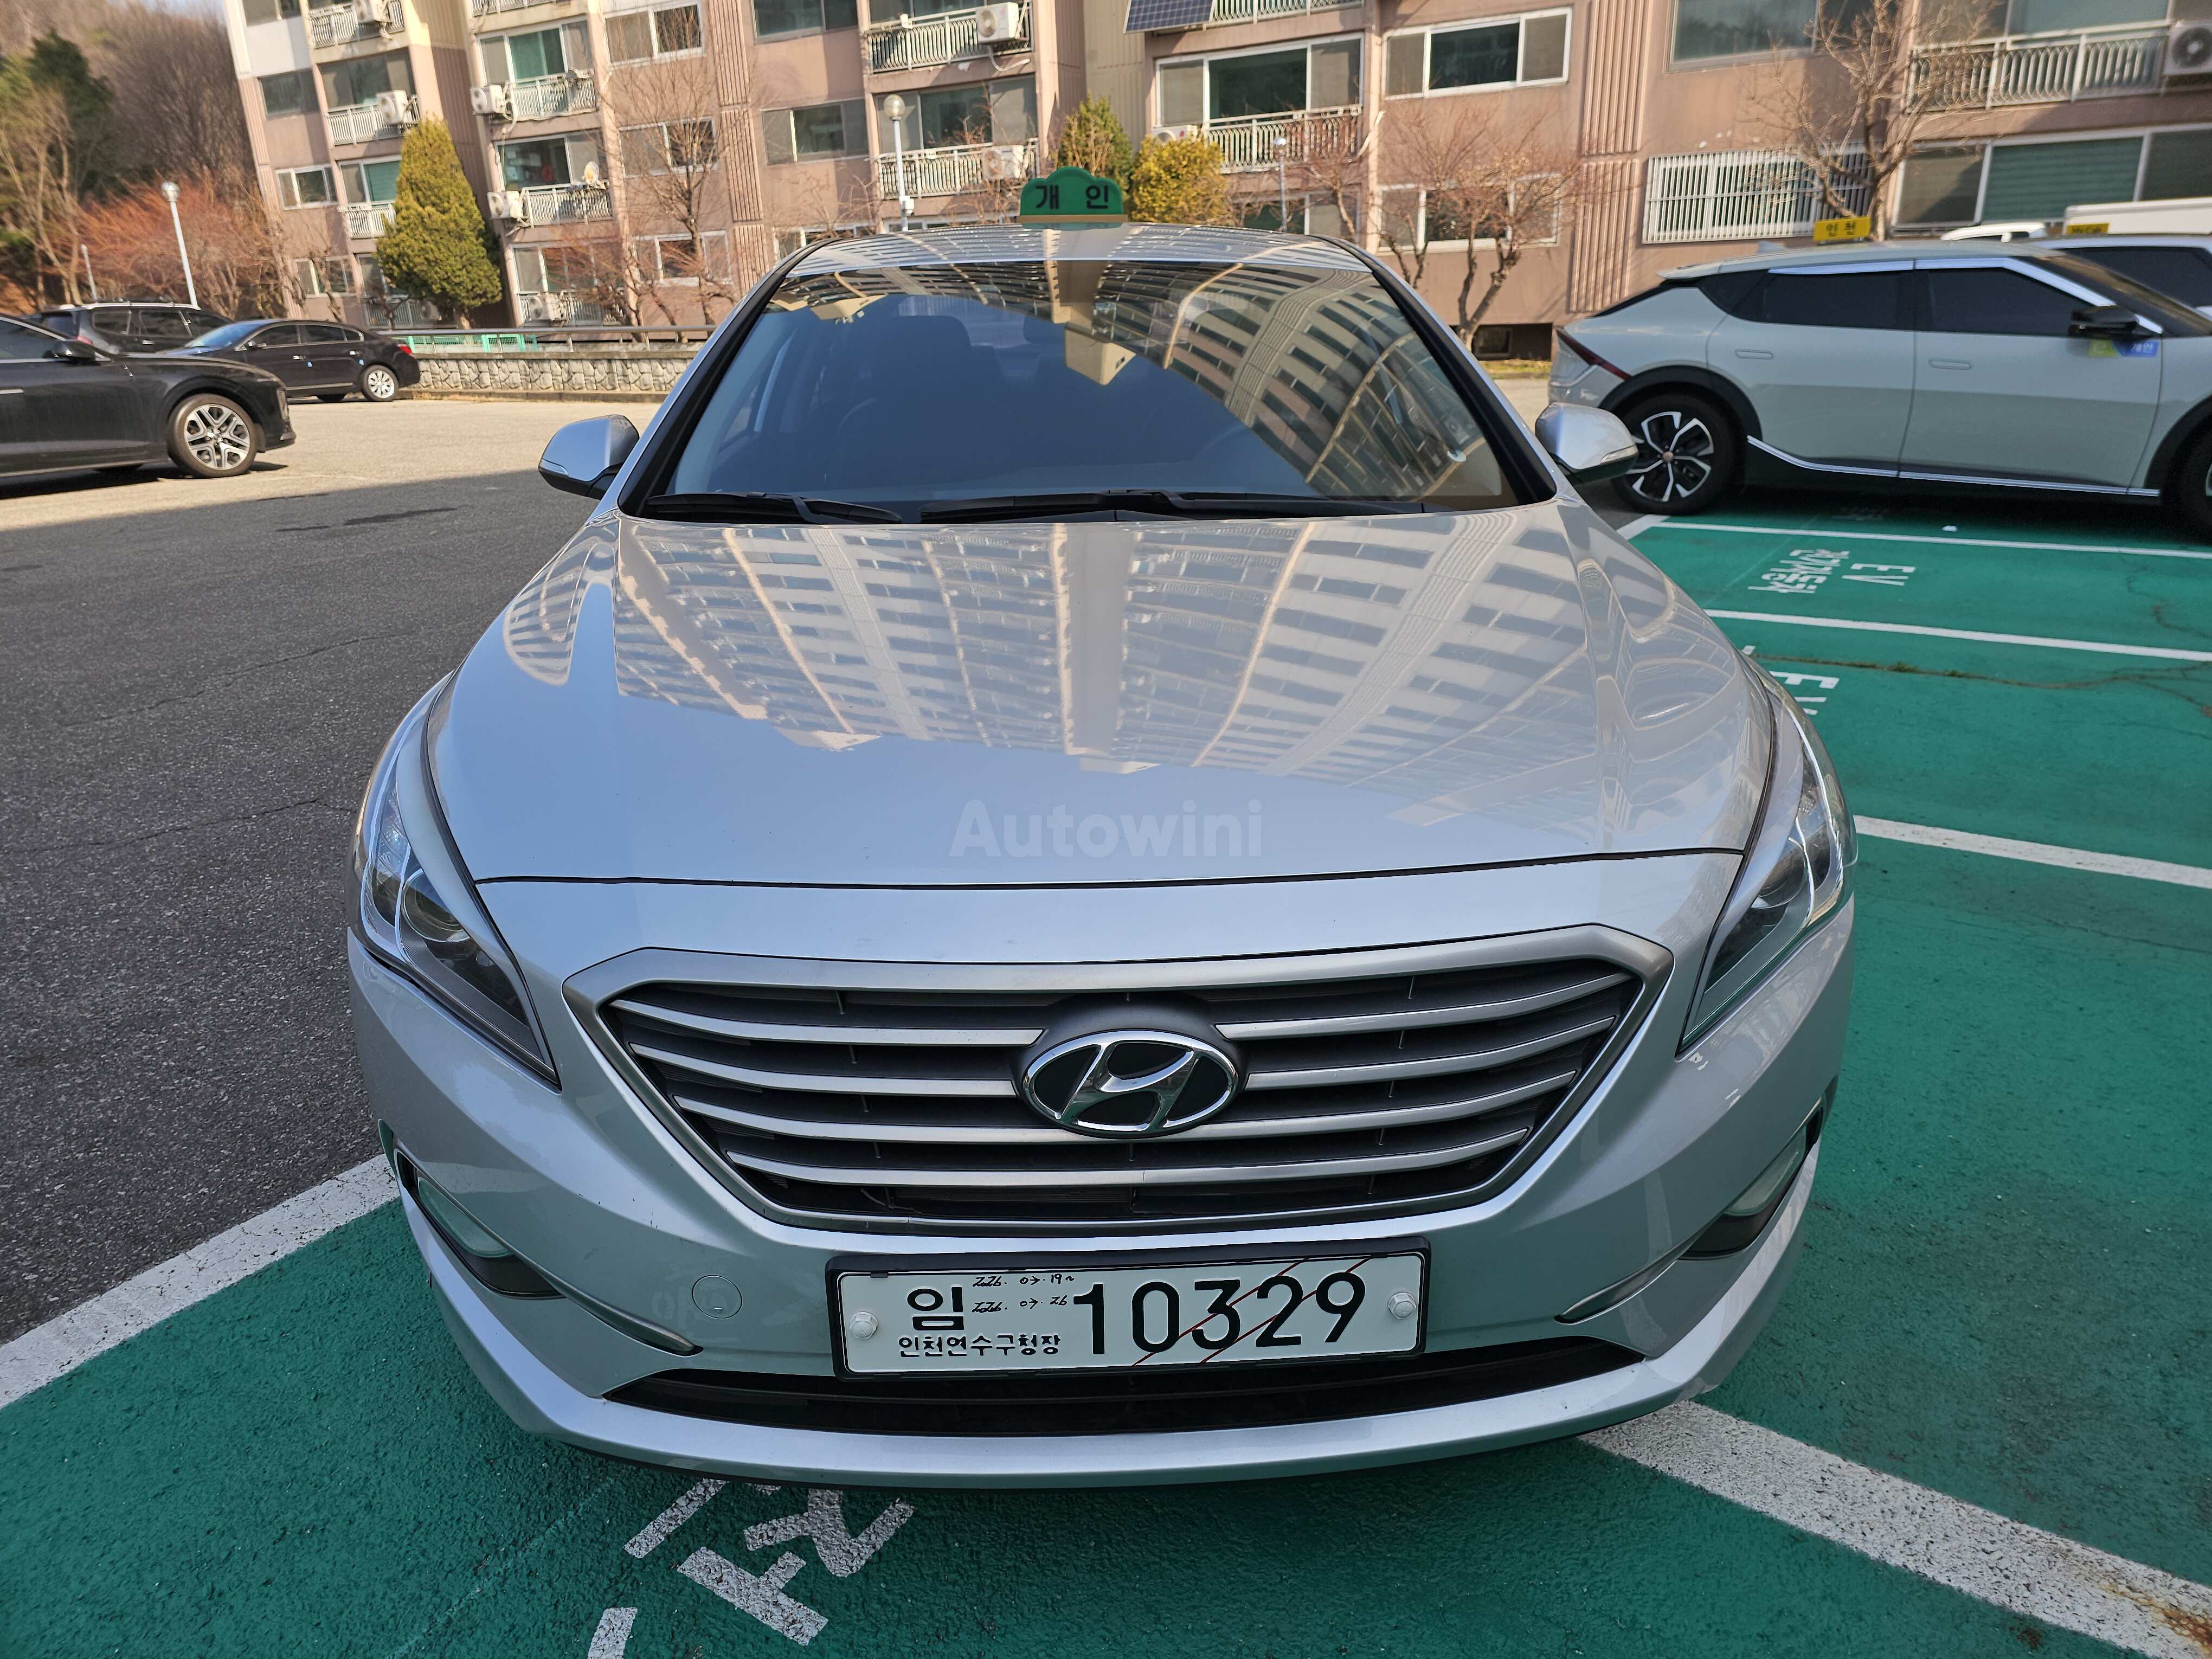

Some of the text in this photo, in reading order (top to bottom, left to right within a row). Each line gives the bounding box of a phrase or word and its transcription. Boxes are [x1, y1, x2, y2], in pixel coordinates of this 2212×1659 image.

[1842, 563, 1916, 586] EV
[907, 1272, 1366, 1355] 임 10329
[898, 1334, 1061, 1358] 인천연수구청장
